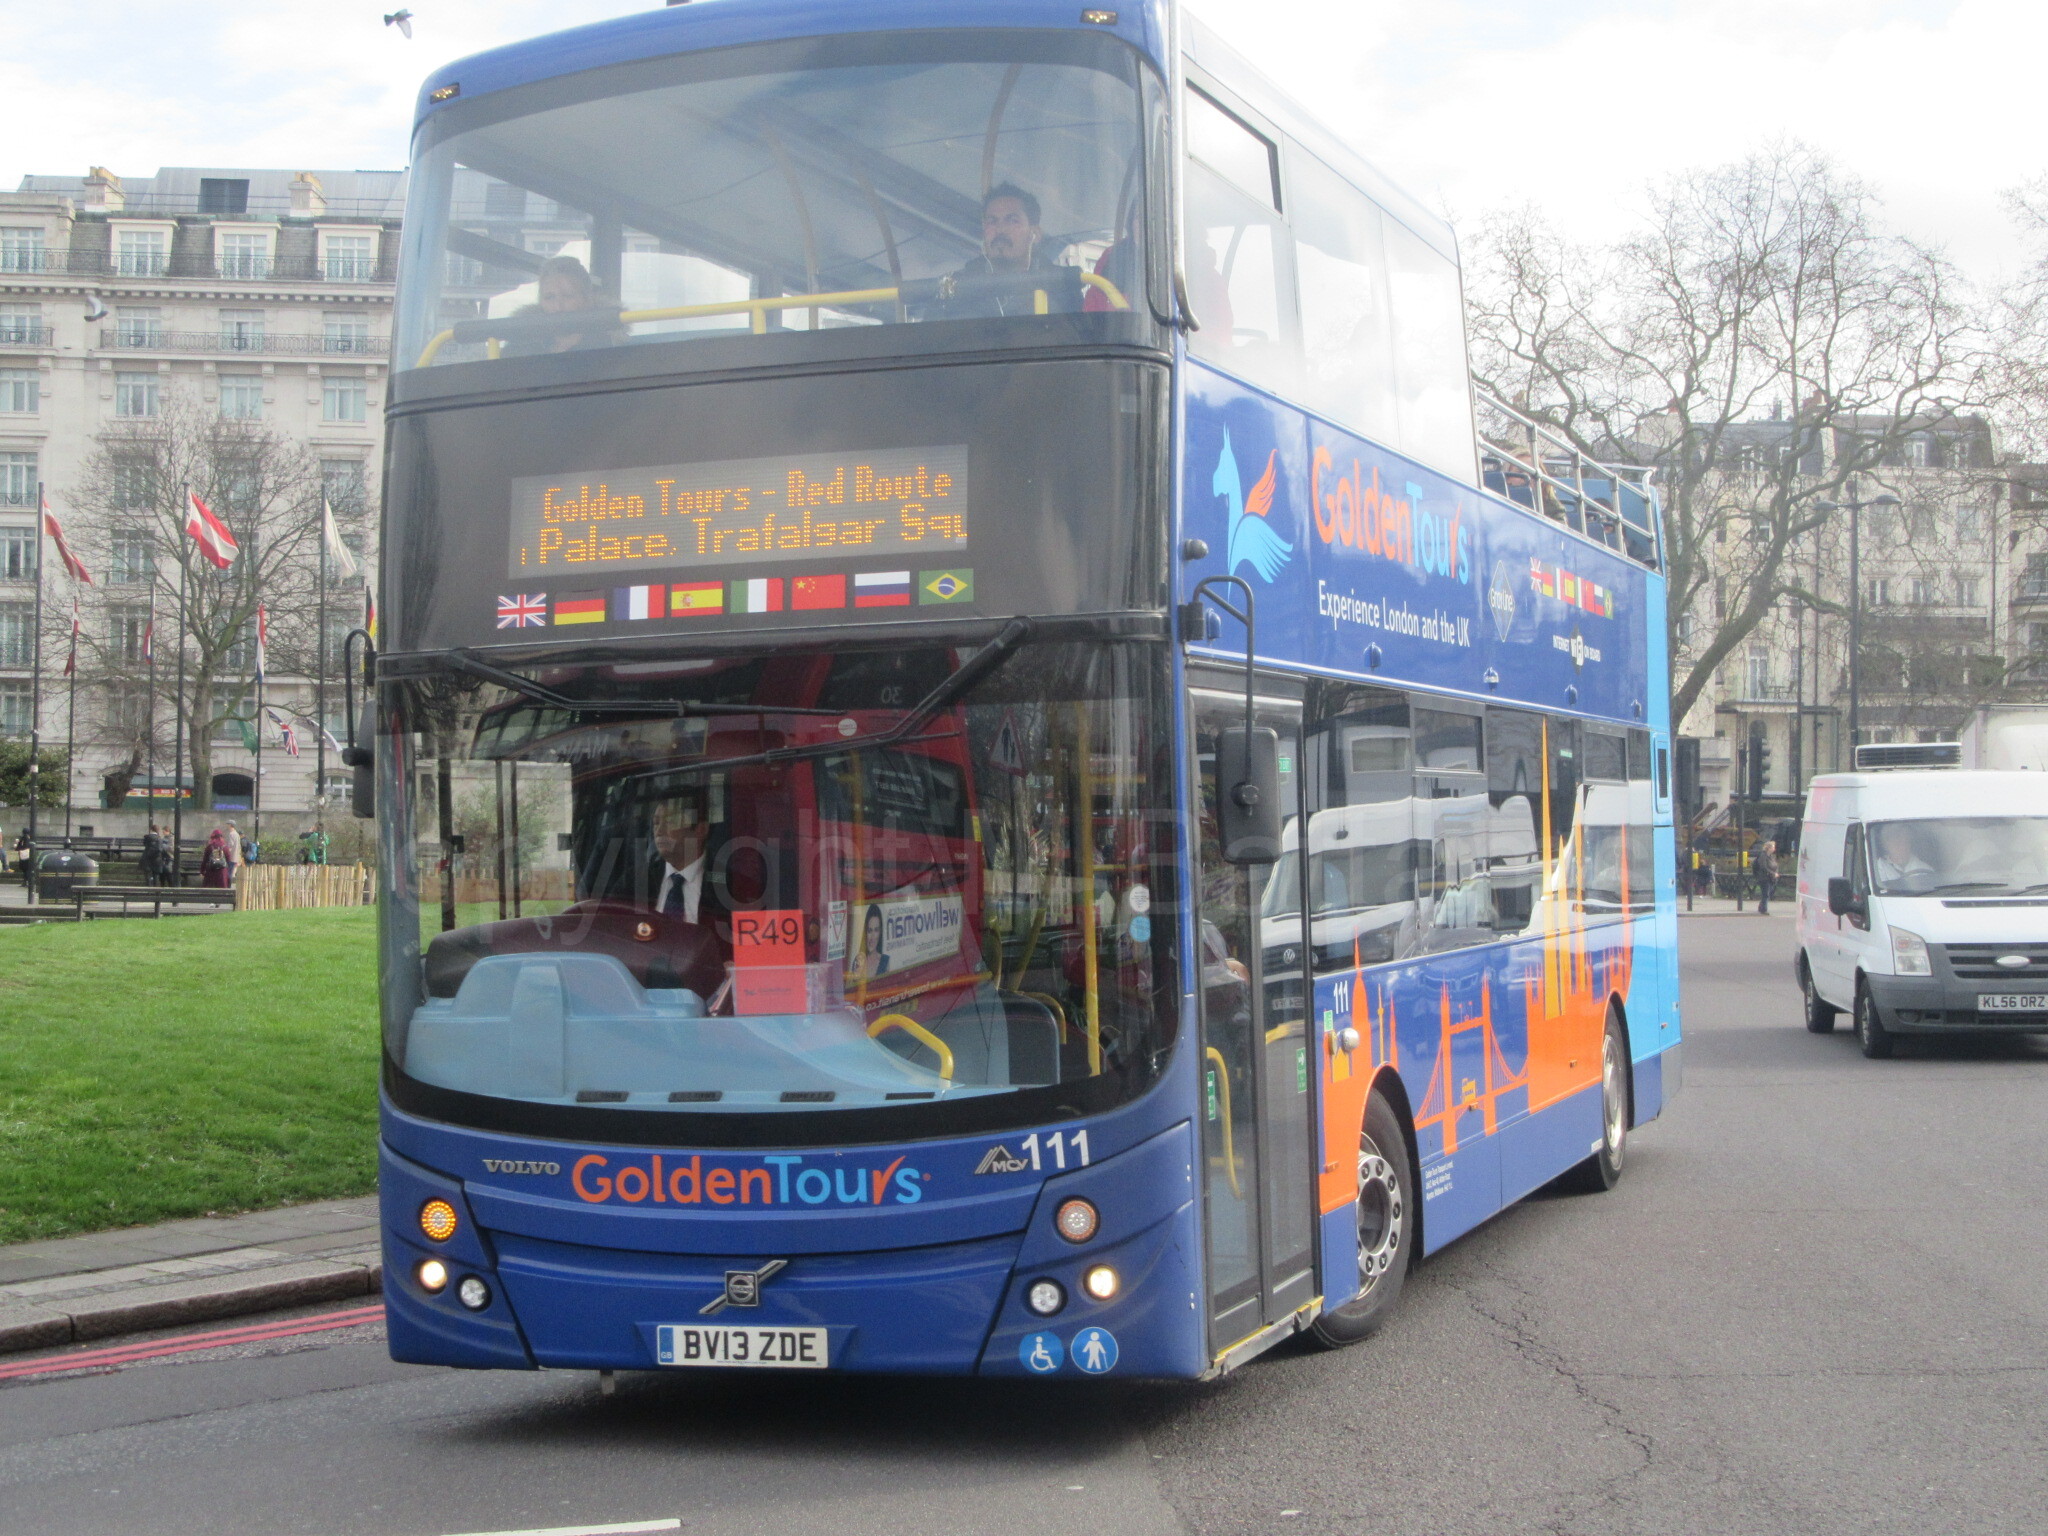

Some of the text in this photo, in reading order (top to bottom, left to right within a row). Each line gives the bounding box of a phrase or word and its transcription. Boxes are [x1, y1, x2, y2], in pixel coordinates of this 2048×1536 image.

[544, 485, 645, 524] Golden
[655, 479, 751, 516] Tours
[787, 467, 844, 508] Red
[855, 466, 953, 503] Route
[1312, 445, 1469, 585] GoldenTours
[692, 510, 886, 555] Trafalgar
[1319, 580, 1471, 647] Experience London and the UK
[737, 918, 799, 946] R49
[1333, 980, 1349, 1014] 111
[1983, 996, 2045, 1008] KL56 ORZ
[992, 1158, 1029, 1173] MCV
[1021, 1129, 1090, 1170] 111
[482, 1158, 560, 1176] VOLVO
[571, 1154, 922, 1204] GoldenTours
[660, 1350, 673, 1360] GB
[683, 1330, 817, 1362] BV13 ZDE
